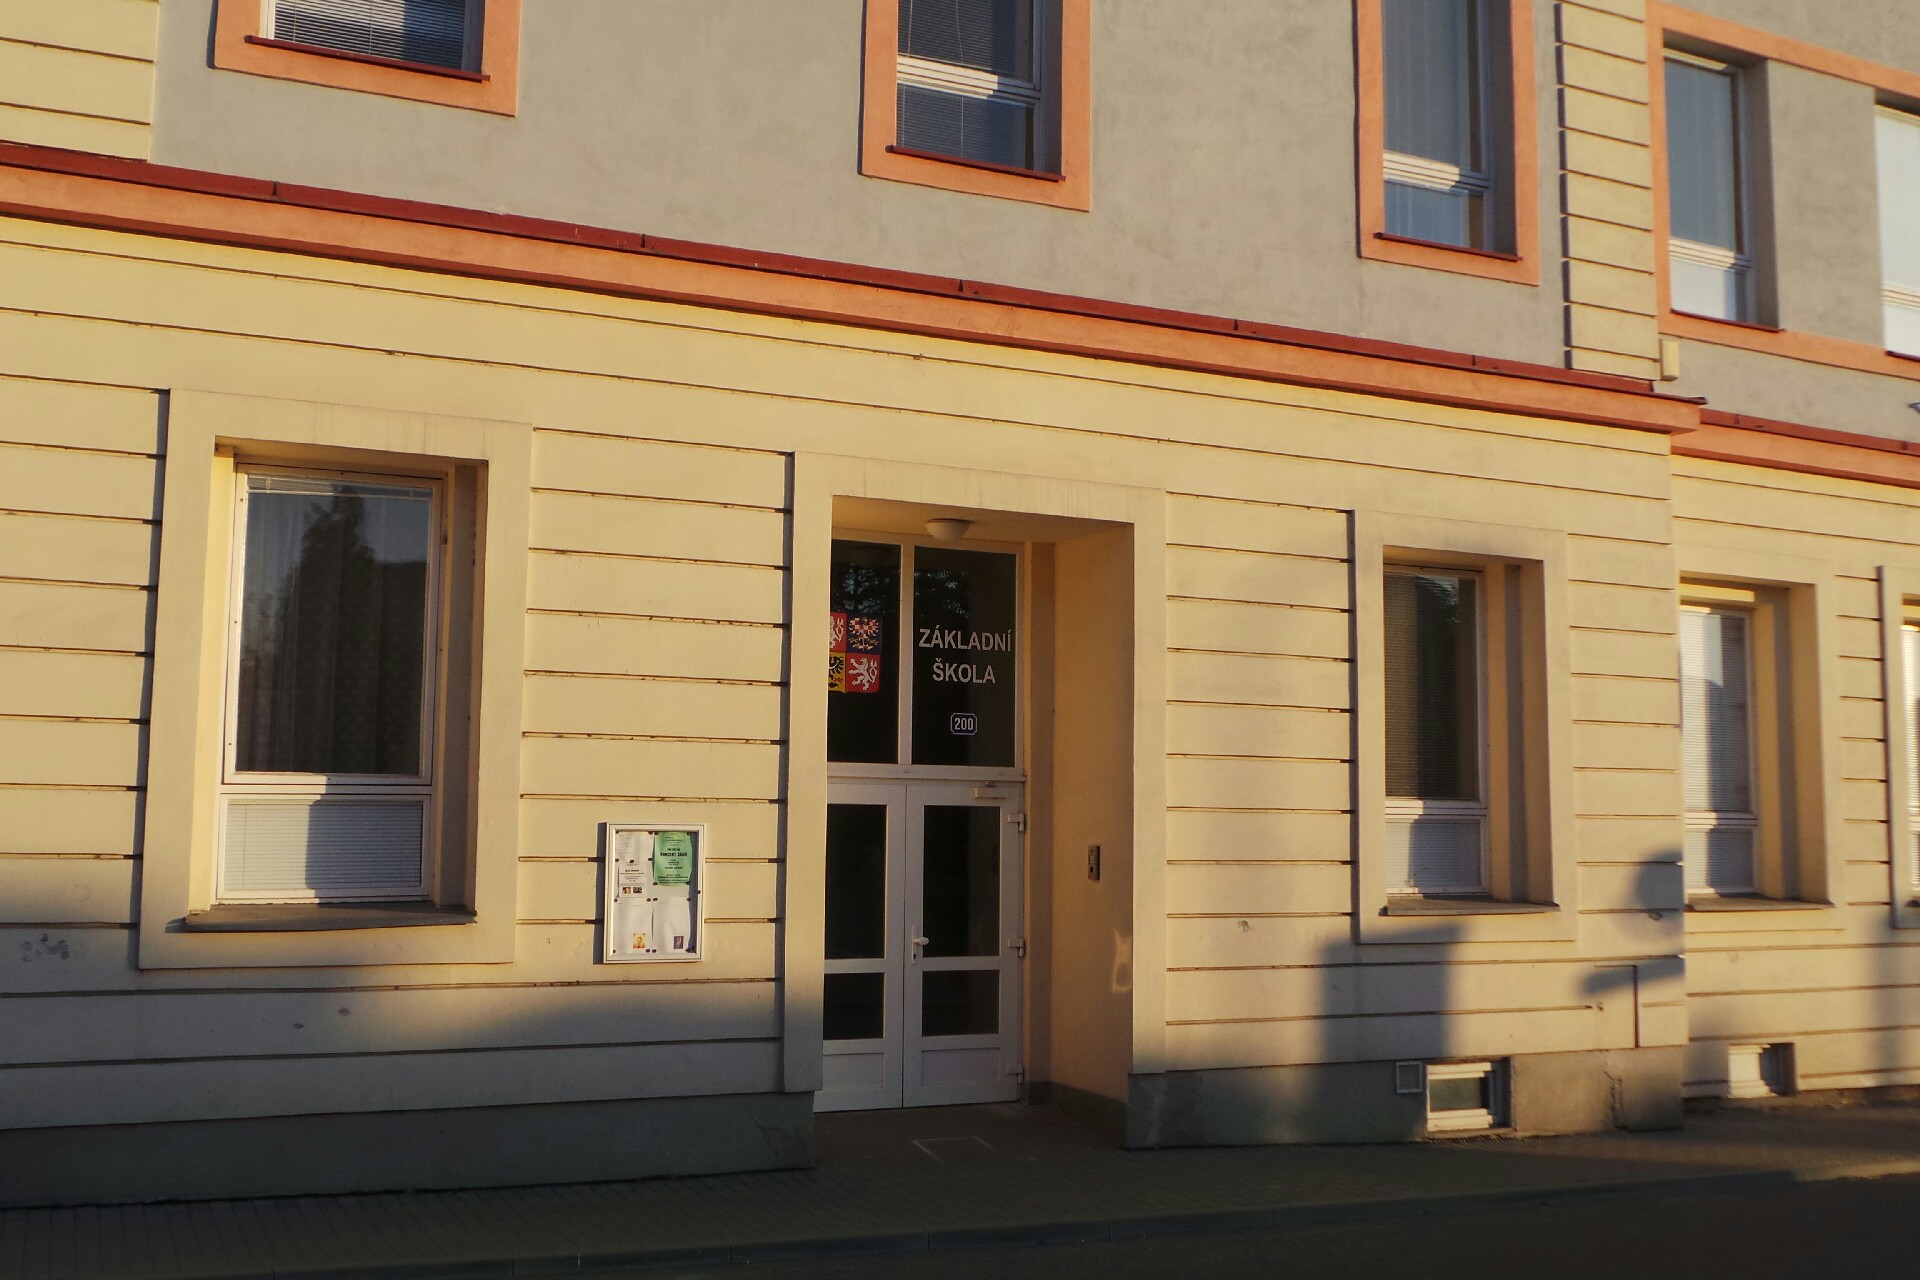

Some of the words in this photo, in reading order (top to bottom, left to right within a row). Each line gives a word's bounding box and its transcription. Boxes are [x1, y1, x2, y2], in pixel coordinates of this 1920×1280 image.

[918, 624, 1012, 652] ZÁKLADNÍ
[932, 657, 996, 684] ŠKOLA
[954, 717, 974, 731] 200
